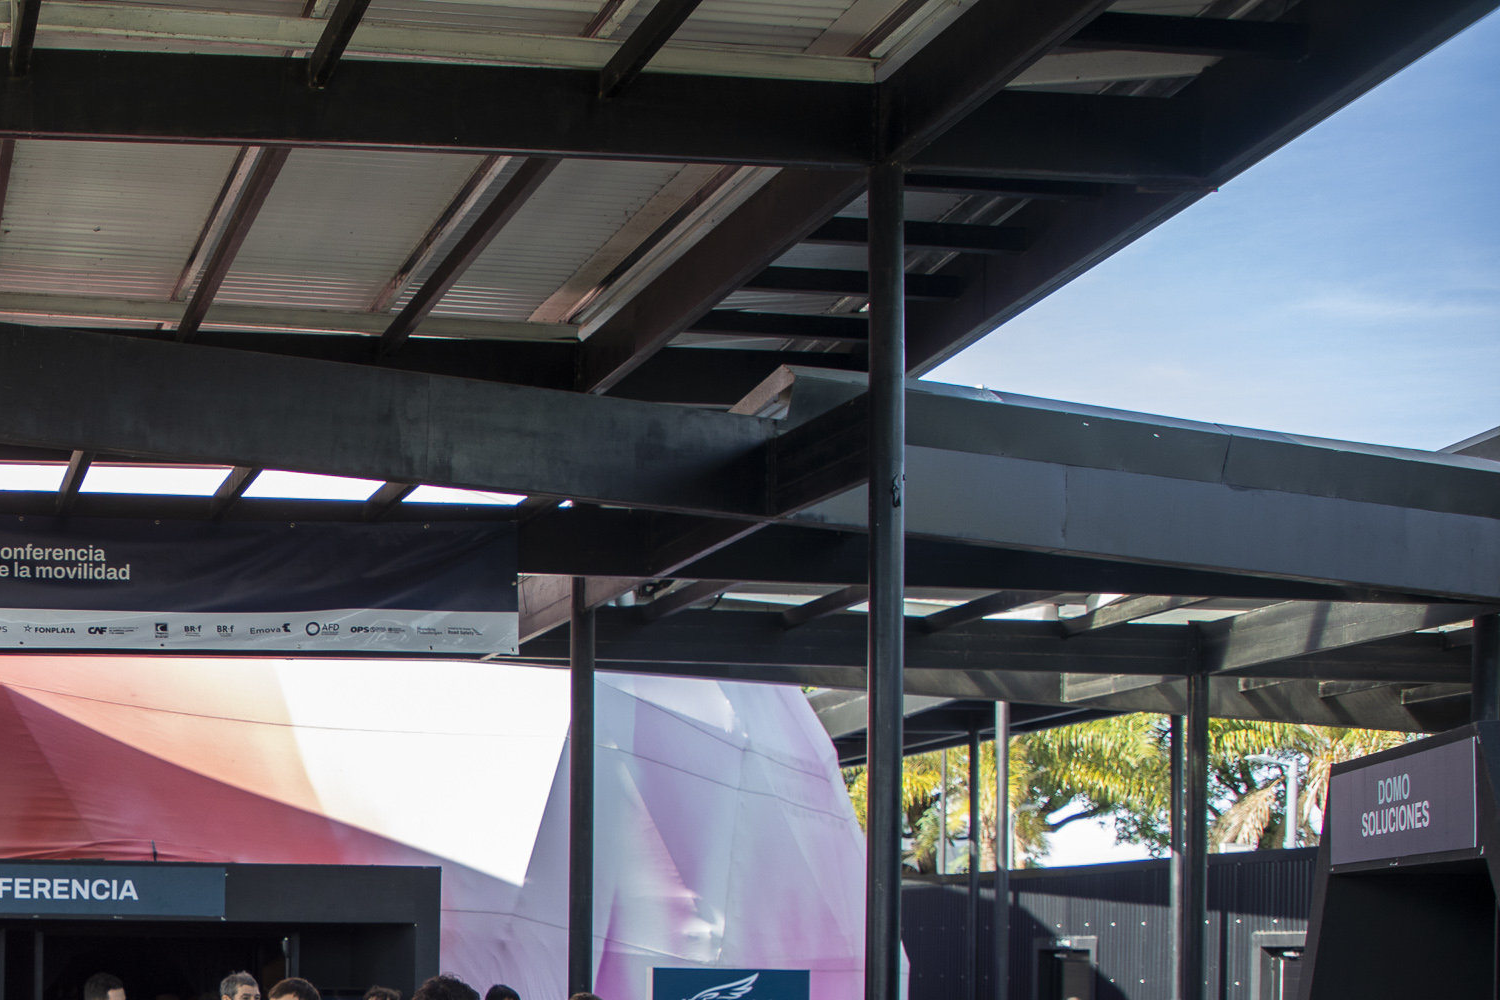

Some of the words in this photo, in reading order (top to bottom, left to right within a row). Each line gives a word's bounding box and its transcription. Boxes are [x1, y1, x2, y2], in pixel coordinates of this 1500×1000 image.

[13, 562, 32, 577] la
[35, 563, 131, 580] movilidad
[87, 626, 107, 635] CAF
[250, 627, 281, 635] Emova
[321, 623, 340, 631] AFD
[1377, 773, 1410, 805] DOMO
[1361, 800, 1430, 838] SOLUCIONES
